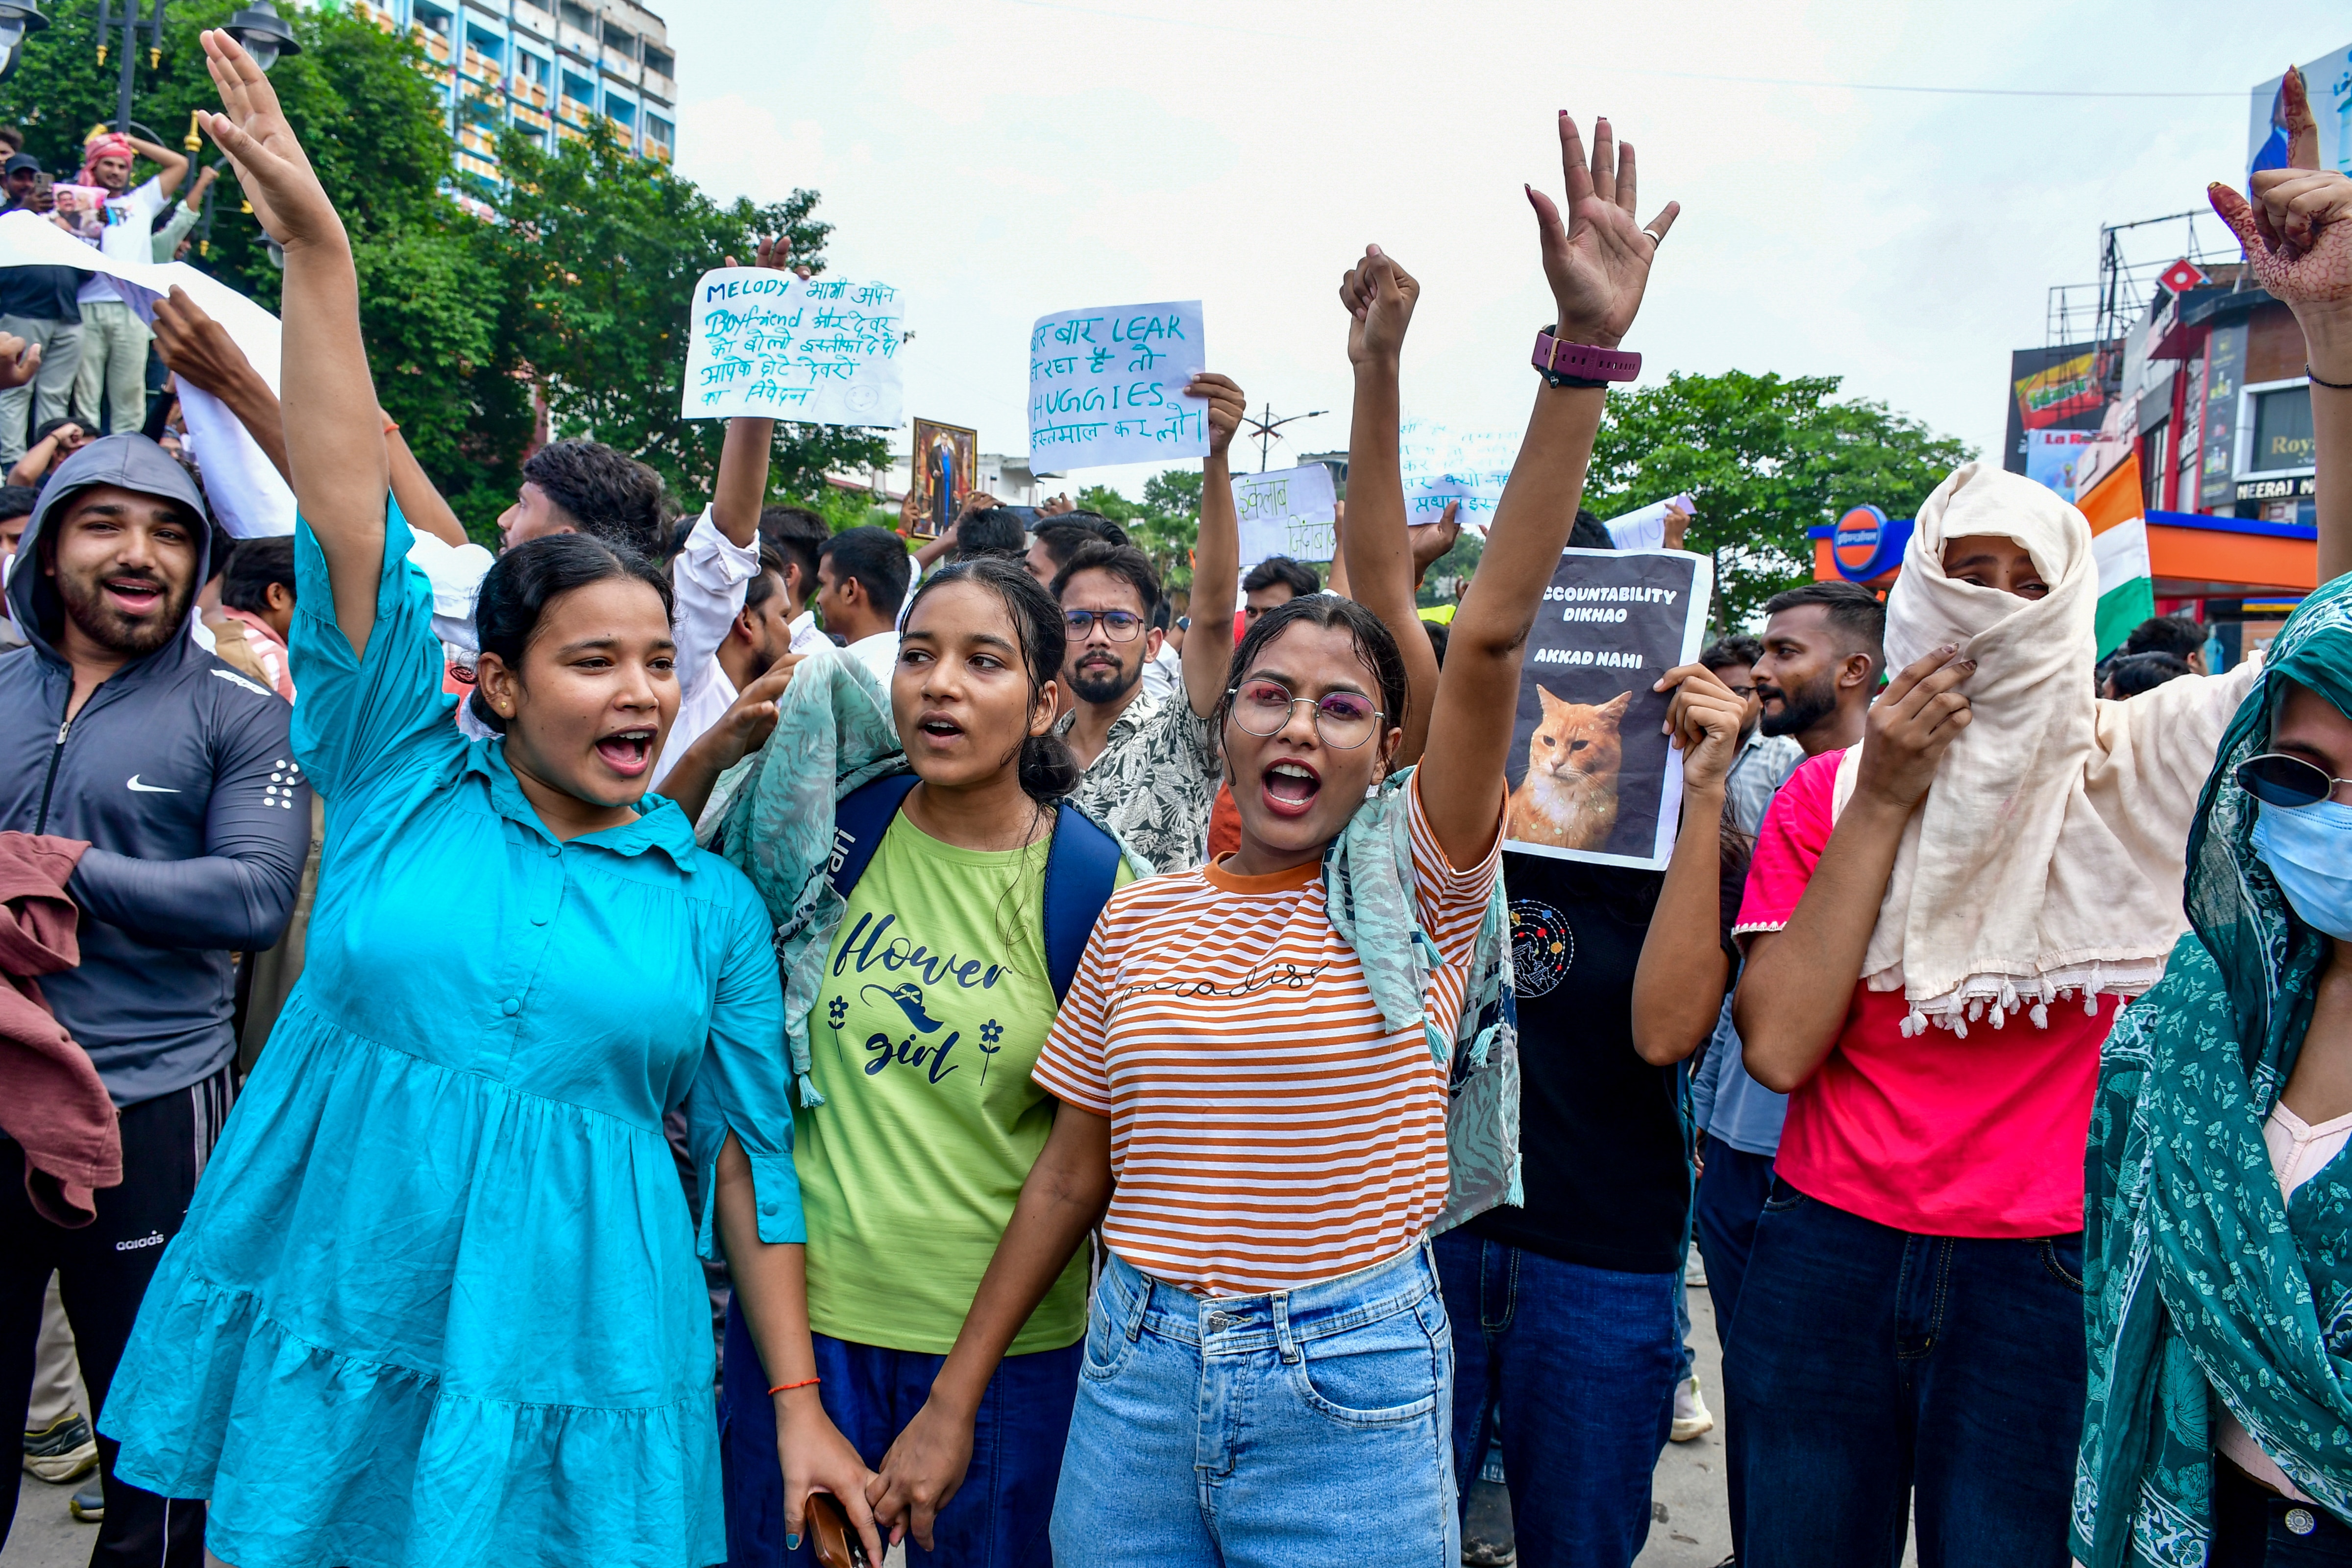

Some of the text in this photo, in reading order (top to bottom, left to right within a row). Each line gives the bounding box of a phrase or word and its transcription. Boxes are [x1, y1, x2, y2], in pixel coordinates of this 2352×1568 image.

[707, 277, 900, 307] MELODY भाभी अपने
[705, 305, 899, 338] Boyfriend और देवर
[1055, 318, 1103, 345] बार
[1112, 315, 1185, 343] LEAK
[709, 337, 737, 359] को
[744, 327, 795, 352] बोलो
[800, 333, 863, 353] इस्तीफा
[861, 335, 880, 355] दे
[701, 353, 860, 386] आपके छोटे देवरों
[1045, 357, 1078, 378] रहा
[1085, 346, 1115, 373] है
[1128, 344, 1166, 372] तो
[701, 390, 731, 406] का
[745, 379, 814, 407] निवेदन
[1034, 382, 1163, 422] HUGGIES
[1032, 419, 1108, 452] इस्तेमाल
[1115, 419, 1152, 438] कर
[1239, 479, 1289, 521] इंकलाब
[1543, 586, 1677, 605] CCOUNTABILITY
[1563, 608, 1627, 623] DIKHAO
[1534, 648, 1643, 670] AKKAD NAHI
[833, 911, 1013, 989] flower
[1110, 961, 1330, 1028] paradise
[865, 1031, 960, 1085] girl
